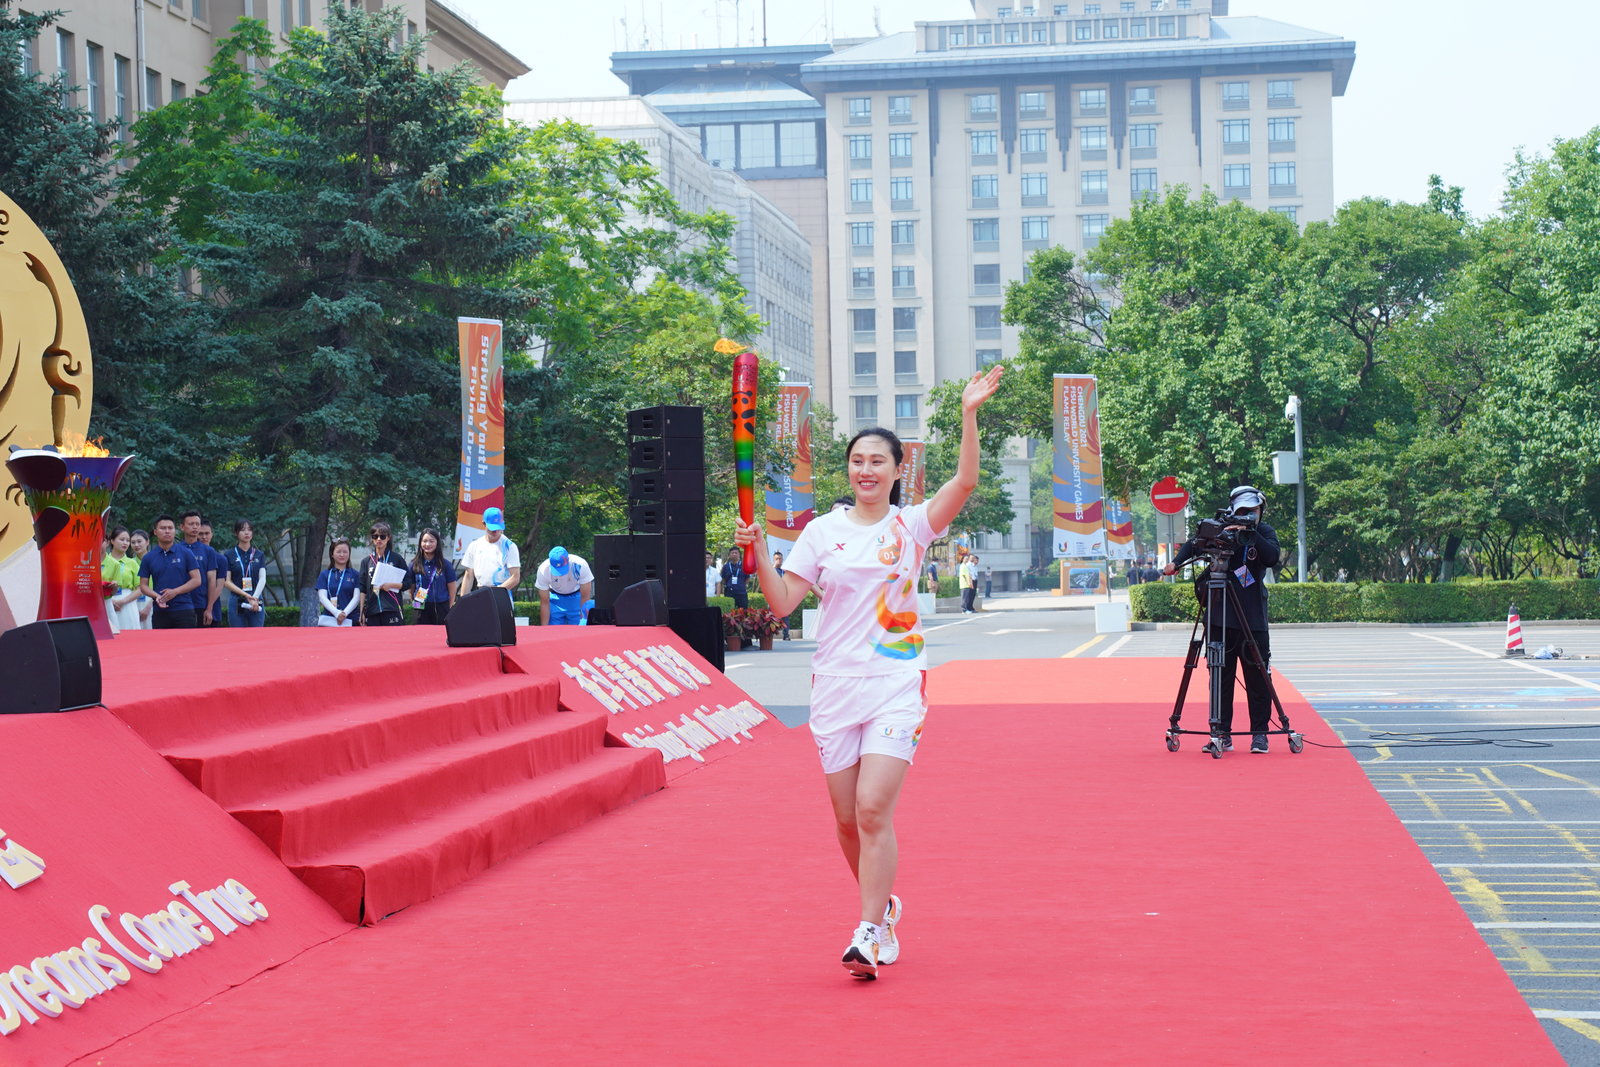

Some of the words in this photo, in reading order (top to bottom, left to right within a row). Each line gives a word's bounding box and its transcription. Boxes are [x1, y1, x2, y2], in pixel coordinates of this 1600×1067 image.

[466, 366, 477, 425] Flying
[477, 335, 489, 414] Striving
[1070, 405, 1078, 437] WORLD
[1077, 385, 1086, 428] CHENGDU
[477, 420, 488, 475] Youth
[1063, 415, 1071, 444] RELAY
[1079, 428, 1088, 448] 2021
[463, 431, 475, 503] Dreams
[1072, 438, 1082, 489] UNIVERSITY
[784, 498, 795, 528] GAMES
[1074, 490, 1084, 521] GAMES
[883, 551, 896, 561] 01
[88, 904, 215, 974] Come
[168, 878, 269, 936] True
